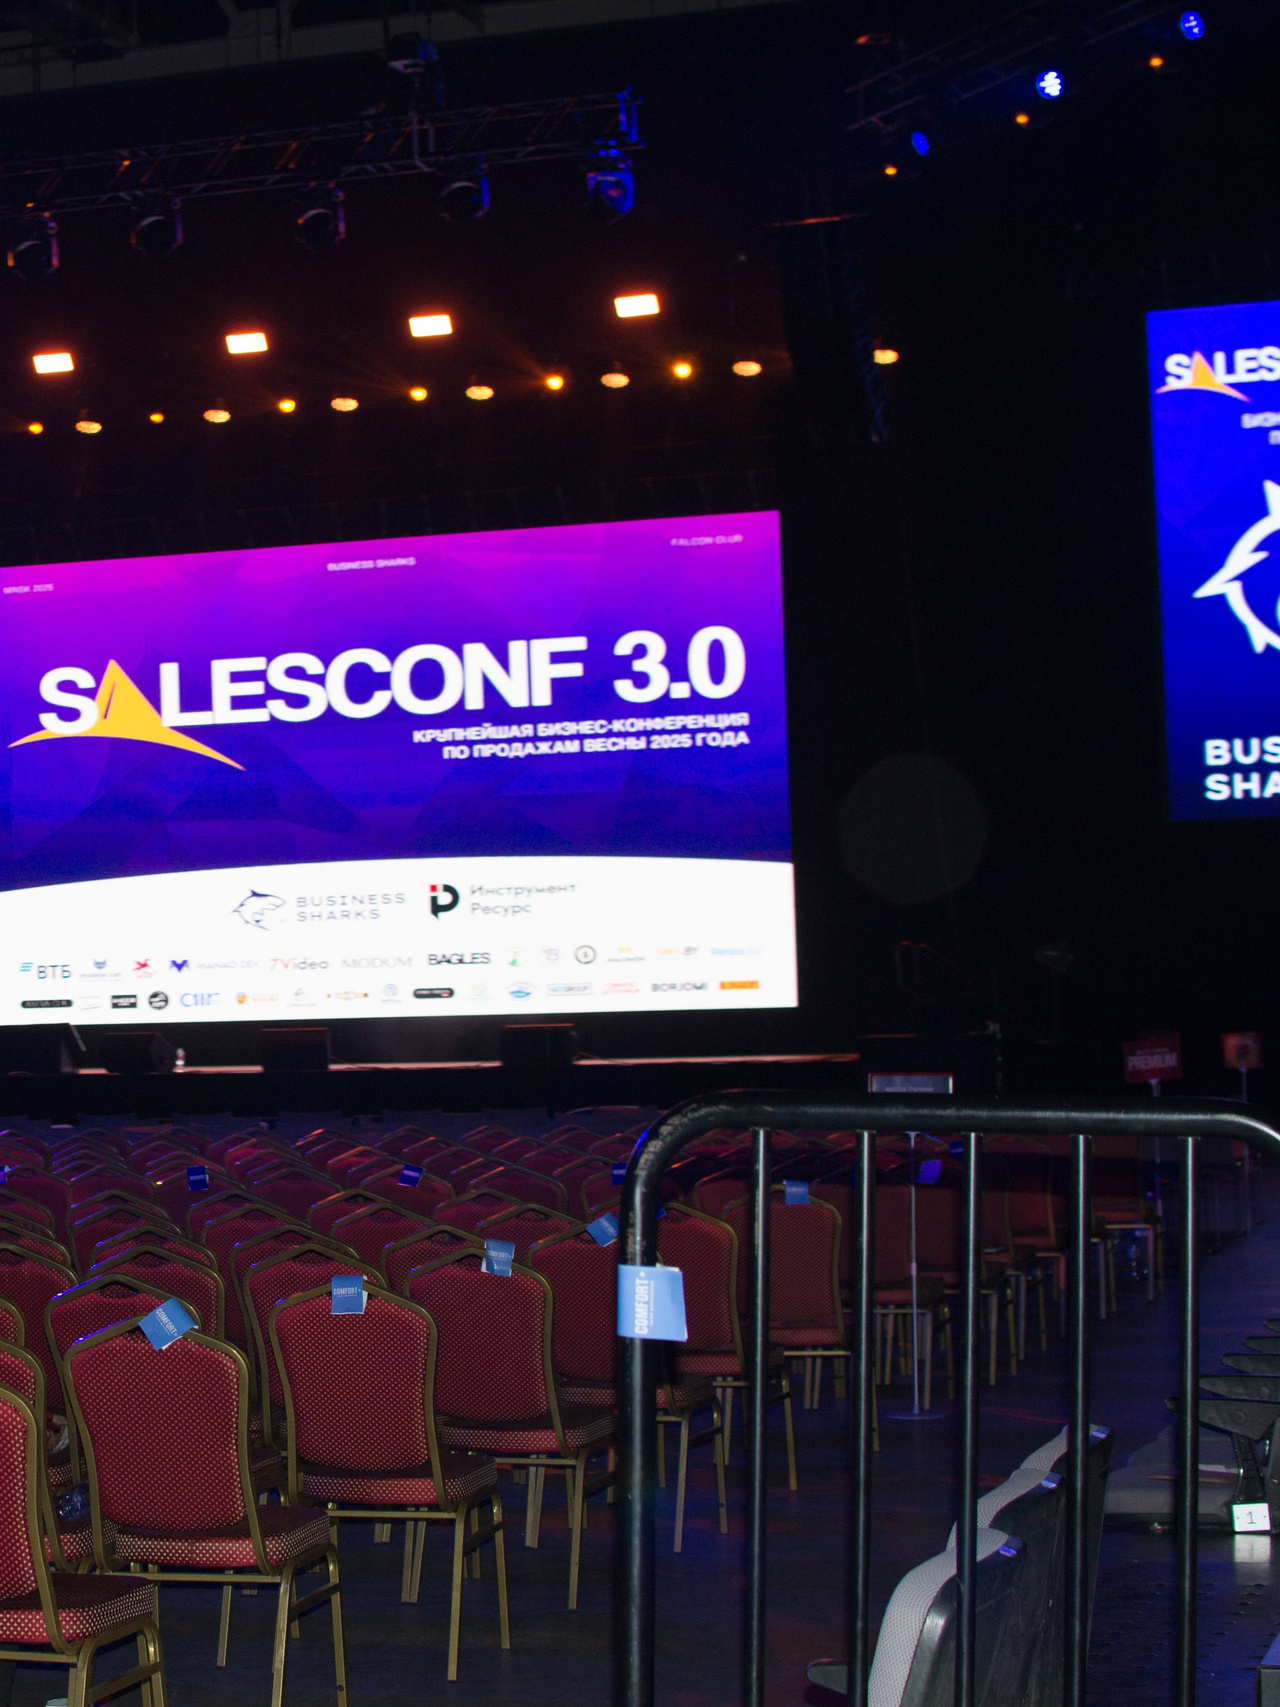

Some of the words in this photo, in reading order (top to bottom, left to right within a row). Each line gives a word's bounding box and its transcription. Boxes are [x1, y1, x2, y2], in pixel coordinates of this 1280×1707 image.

[38, 636, 588, 734] SALESCONF
[612, 625, 746, 703] 3.0
[412, 723, 534, 744] КРУПНЕЙШАЯ
[536, 712, 750, 738] БИЗНЕС-КОНФЕРЕНЦИЯ
[442, 745, 470, 759] ПО
[473, 739, 580, 758] ПРОДАЖАМ
[582, 736, 647, 752] ВЕСНЫ
[650, 733, 693, 749] 2025
[695, 730, 750, 748] ГОДА
[470, 883, 577, 897] Инструмент
[297, 893, 407, 908] BUSINESS
[297, 909, 381, 922] SHARKS
[470, 902, 532, 916] Ресурс
[269, 957, 329, 970] 7Video
[341, 957, 413, 969] MODUM
[428, 952, 491, 966] BAGLES
[37, 964, 71, 979] ВТБ
[651, 983, 708, 993] BORJOMI
[1127, 1052, 1178, 1070] PREMIUM
[1246, 1511, 1257, 1524] 1
